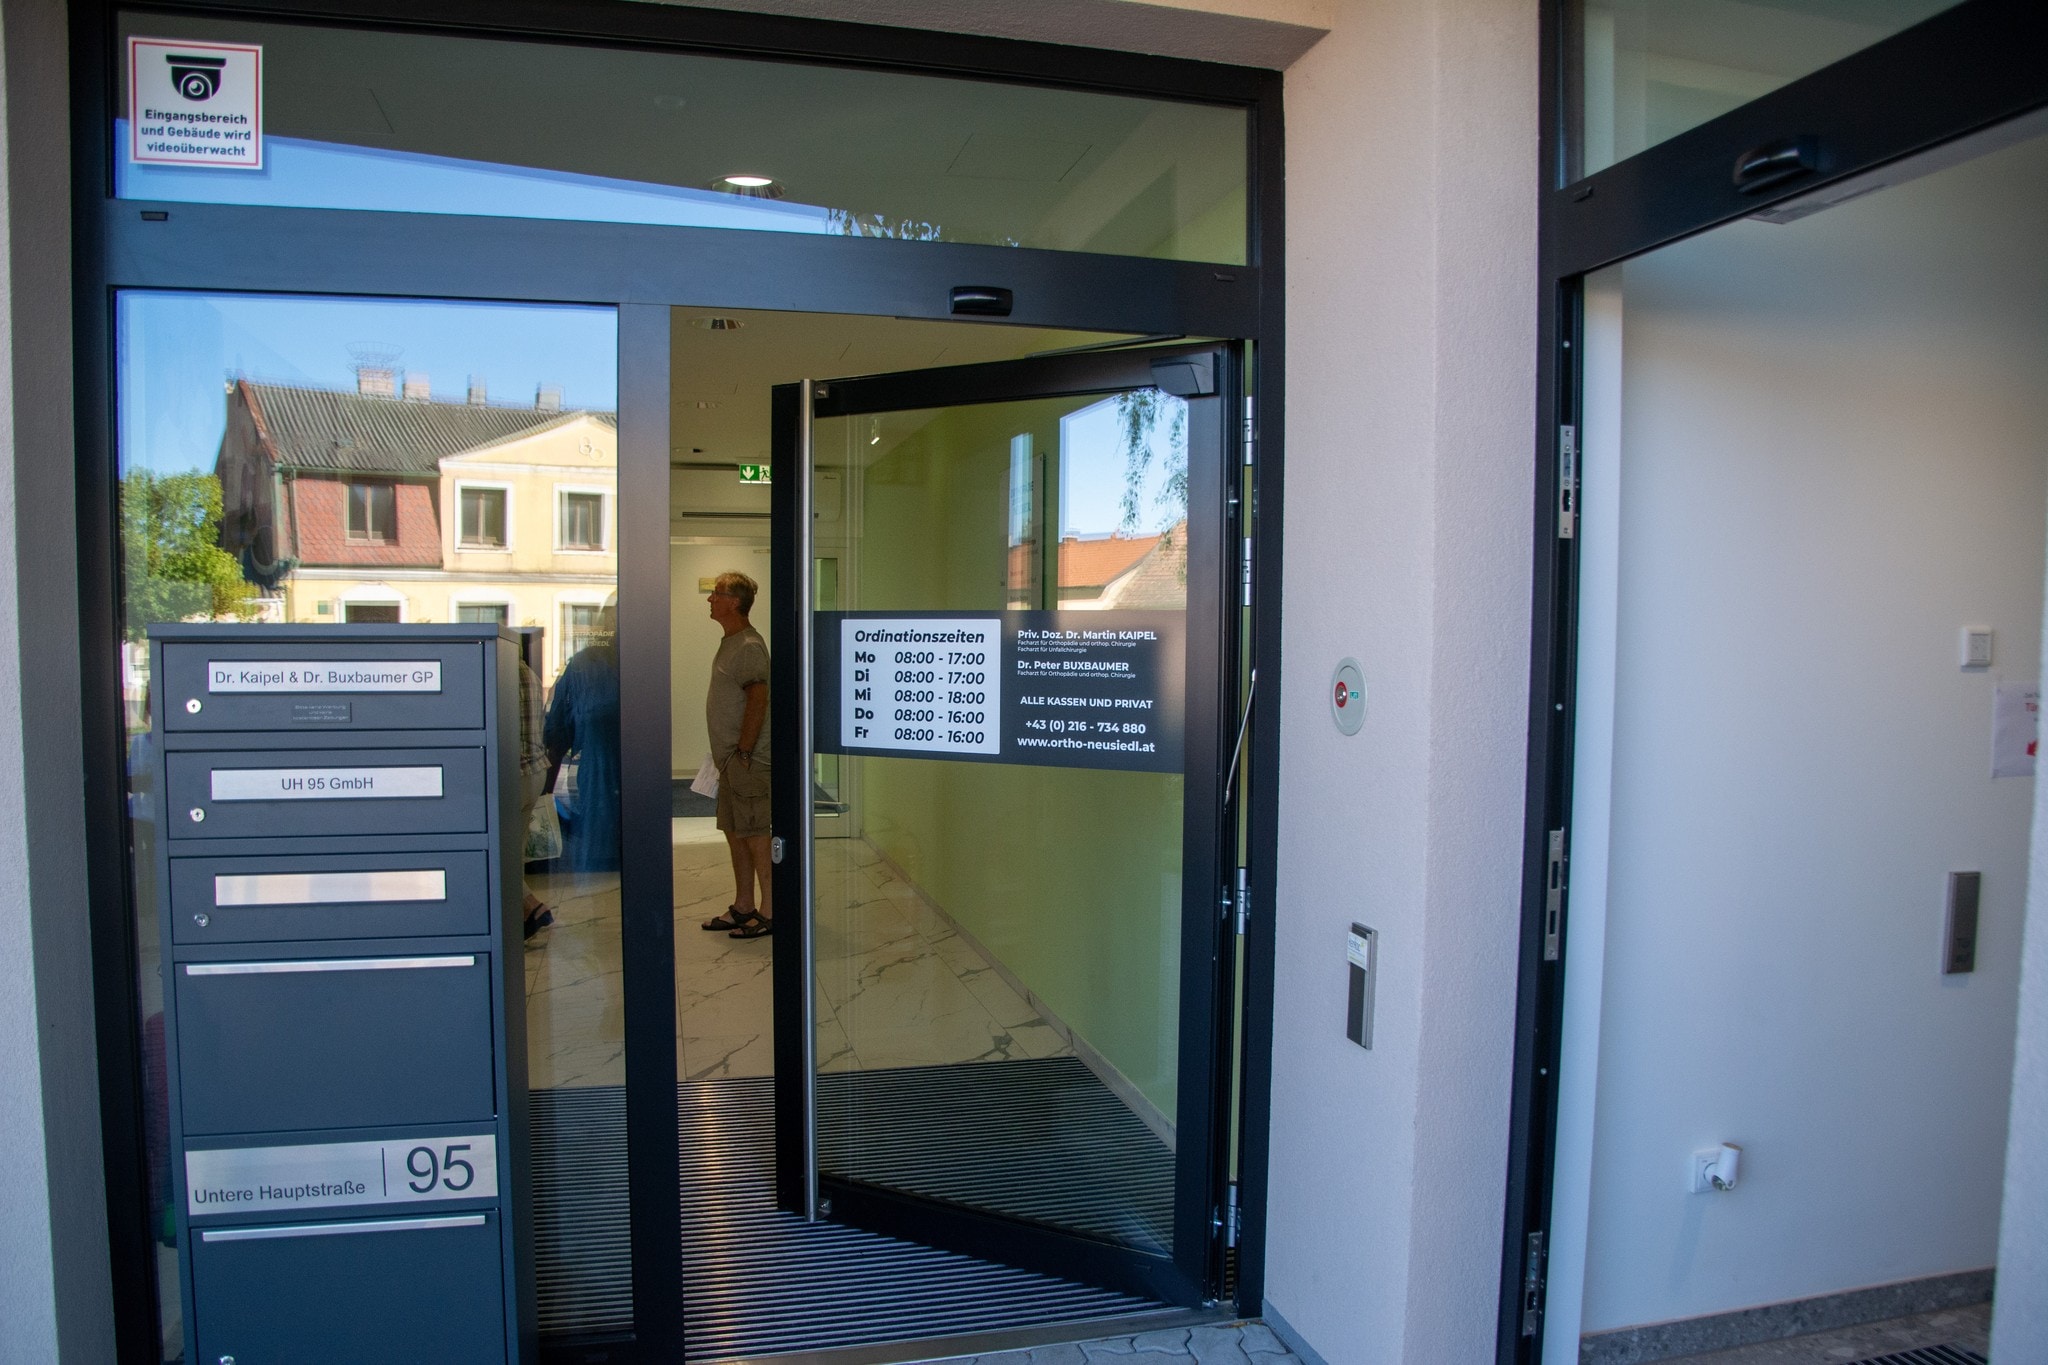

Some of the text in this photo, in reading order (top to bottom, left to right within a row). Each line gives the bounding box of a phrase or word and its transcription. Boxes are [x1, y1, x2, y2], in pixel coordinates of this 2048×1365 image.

[145, 109, 247, 125] Eingangsbereich
[141, 126, 251, 140] und Gebäude wird
[147, 142, 246, 156] videoüberwacht
[854, 629, 985, 643] Ordinationszeiten
[1017, 630, 1157, 640] Priv. Doz. Dr. Martin KAIPEL
[1048, 646, 1087, 654] Unfallchirurgie
[1091, 640, 1110, 648] orthop.
[854, 651, 876, 663] Mo
[894, 651, 935, 664] 08:00
[948, 652, 985, 665] 17:00
[1017, 660, 1130, 672] Dr. Peter BUXBAUMER
[215, 671, 434, 687] Dr. Kaipel & Dr. Buxbaumer GP
[854, 668, 870, 682] Di
[894, 671, 935, 684] 08:00
[948, 672, 985, 685] 17:00
[854, 687, 871, 701] Mi
[894, 690, 935, 703] 08:00
[948, 691, 985, 705] 18:00
[1020, 696, 1153, 709] ALLE KASSEN UND PRIVAT
[854, 707, 874, 720] Do
[894, 709, 935, 722] 08:00
[948, 710, 985, 724] 16:00
[1025, 720, 1047, 730] +43
[1049, 720, 1065, 733] (0)
[1067, 721, 1087, 732] 216
[1097, 722, 1120, 733] 734
[1122, 723, 1146, 734] 880
[854, 726, 869, 739] Fr
[894, 728, 935, 741] 08:00
[948, 730, 985, 744] 16:00
[1017, 737, 1156, 752] www.ortho-neusiedl.at
[281, 776, 374, 791] UH 95 GmbH
[194, 1144, 475, 1204] Untere Hauptstraße 95
